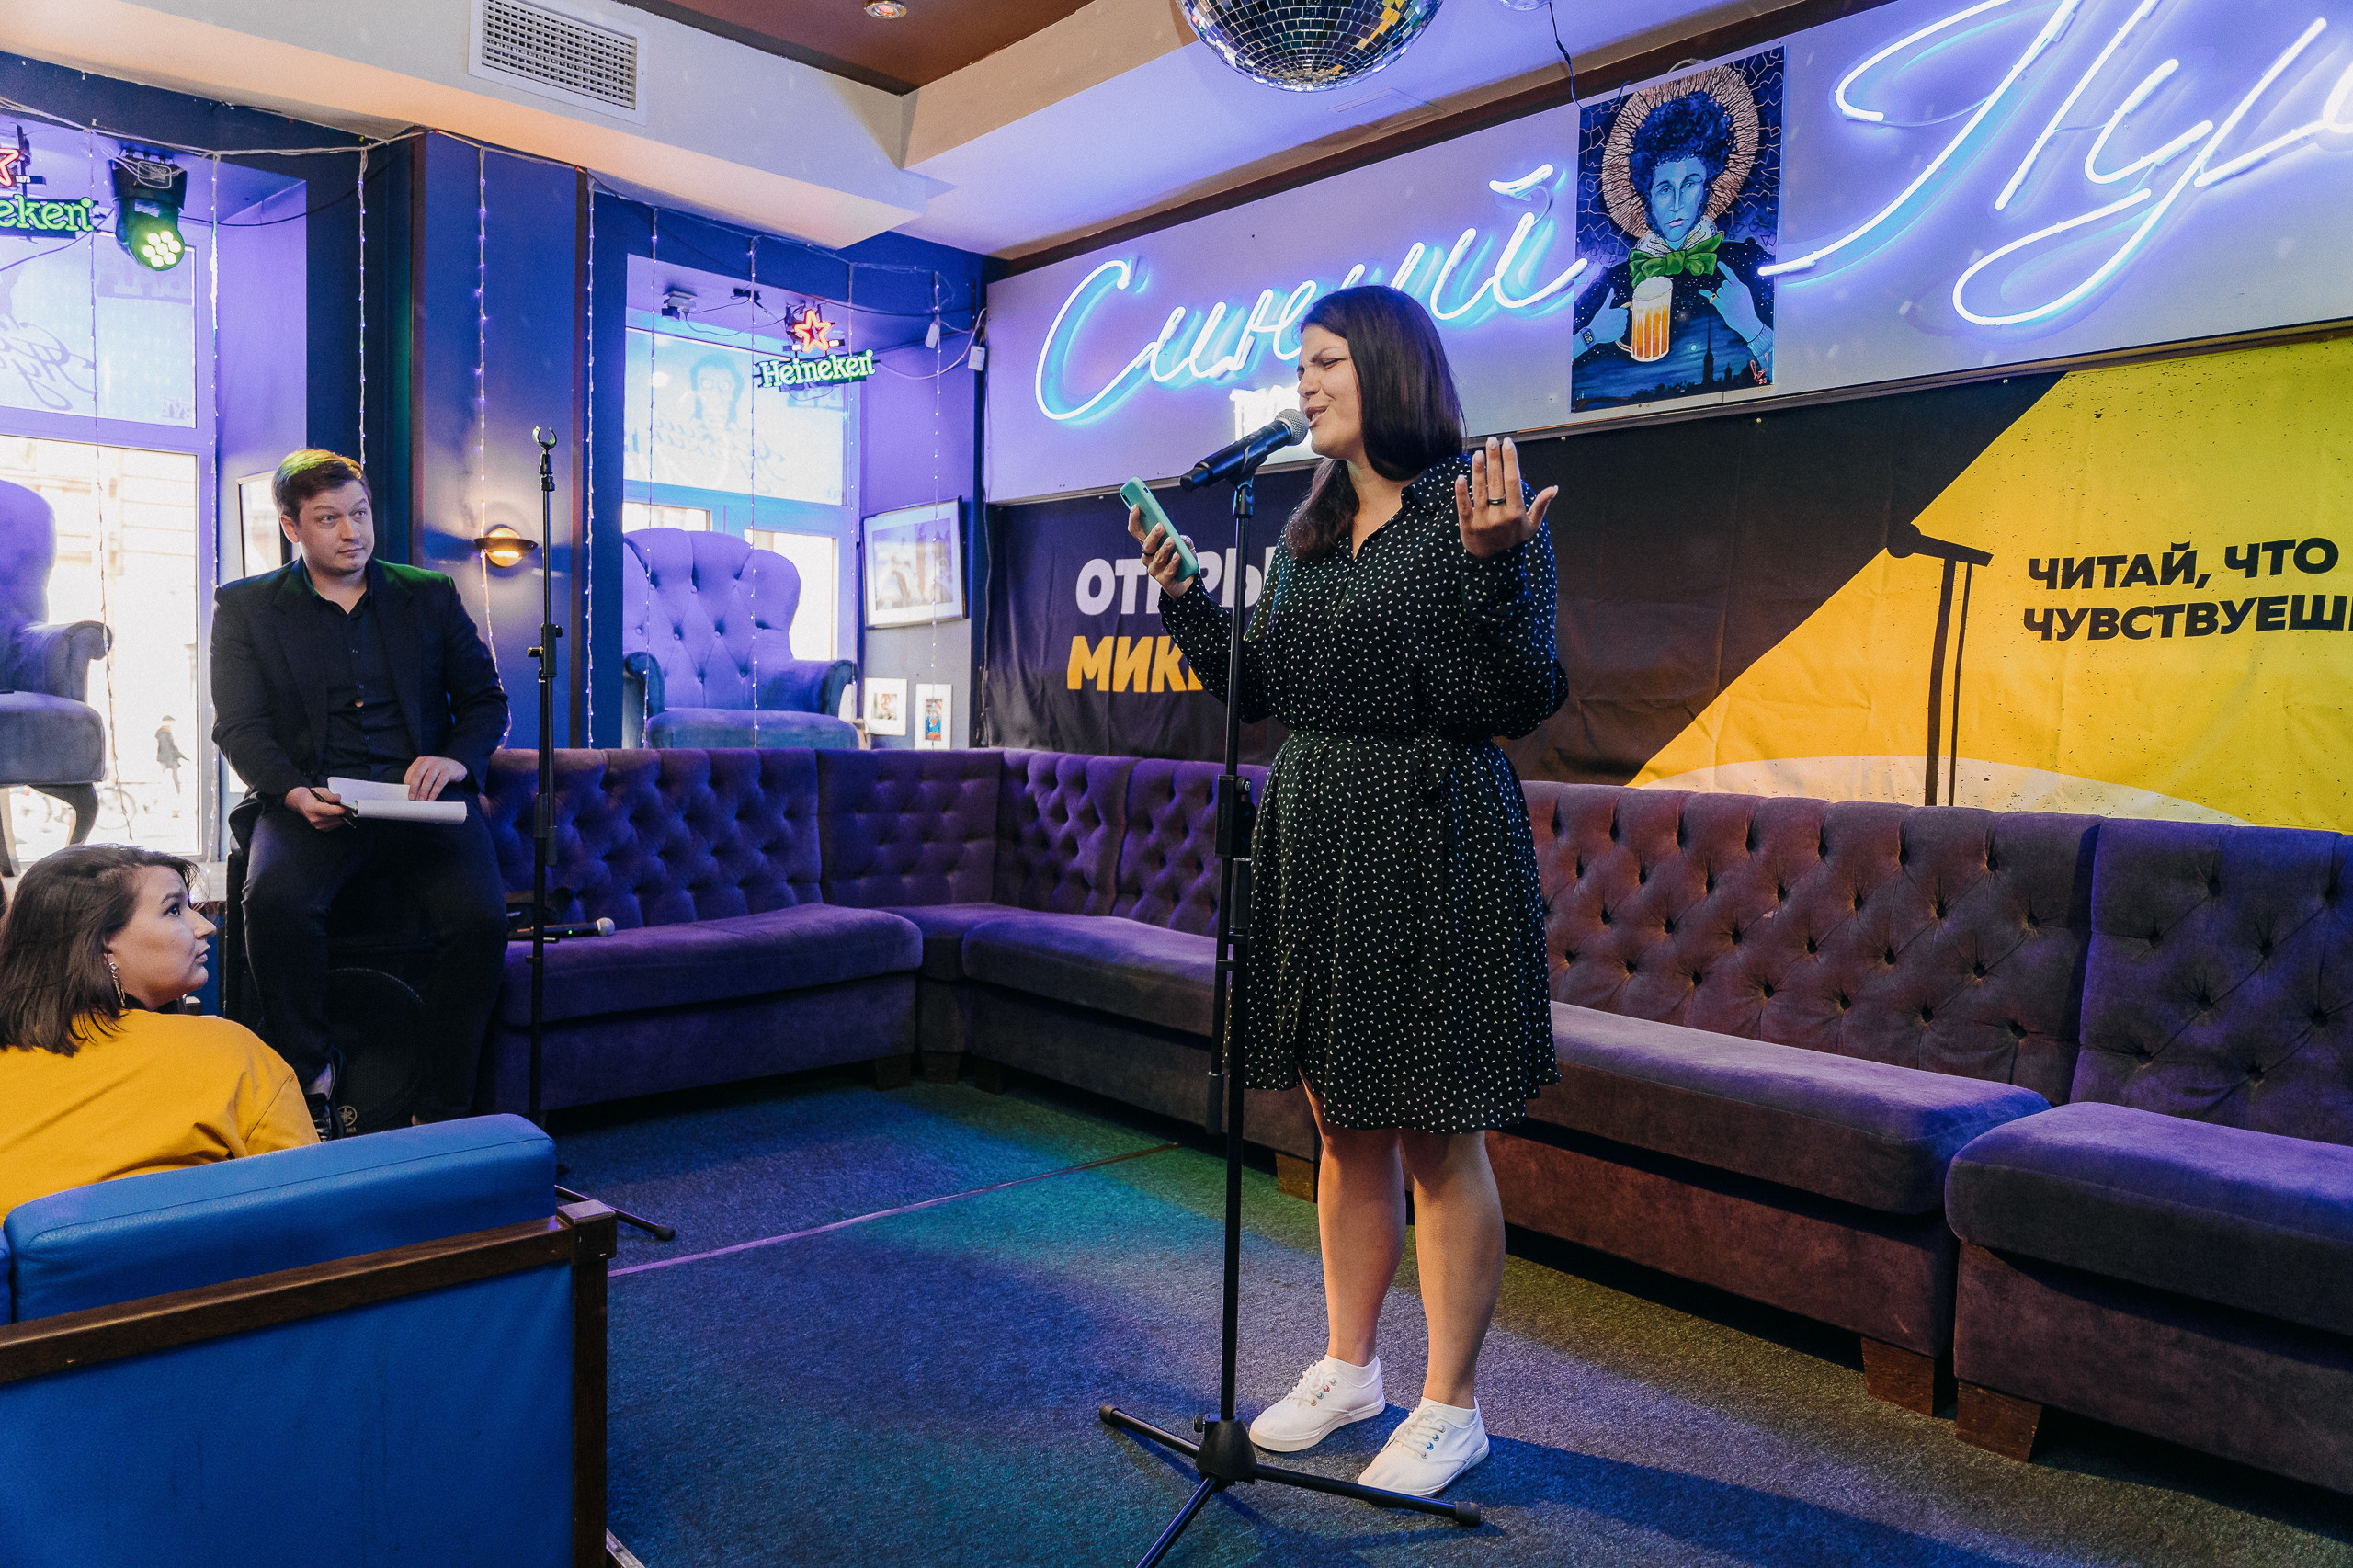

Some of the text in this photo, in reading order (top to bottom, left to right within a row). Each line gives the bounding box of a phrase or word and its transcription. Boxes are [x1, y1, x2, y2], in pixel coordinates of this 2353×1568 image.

[1035, 164, 1588, 421] Синй
[759, 349, 876, 388] Heineken
[1075, 546, 1277, 616] ОТРЫ
[2028, 537, 2339, 590] ЧИТАЙ, ЧТО
[2023, 594, 2353, 642] ЧУВСТВУЕШ
[1067, 635, 1204, 693] МИК
